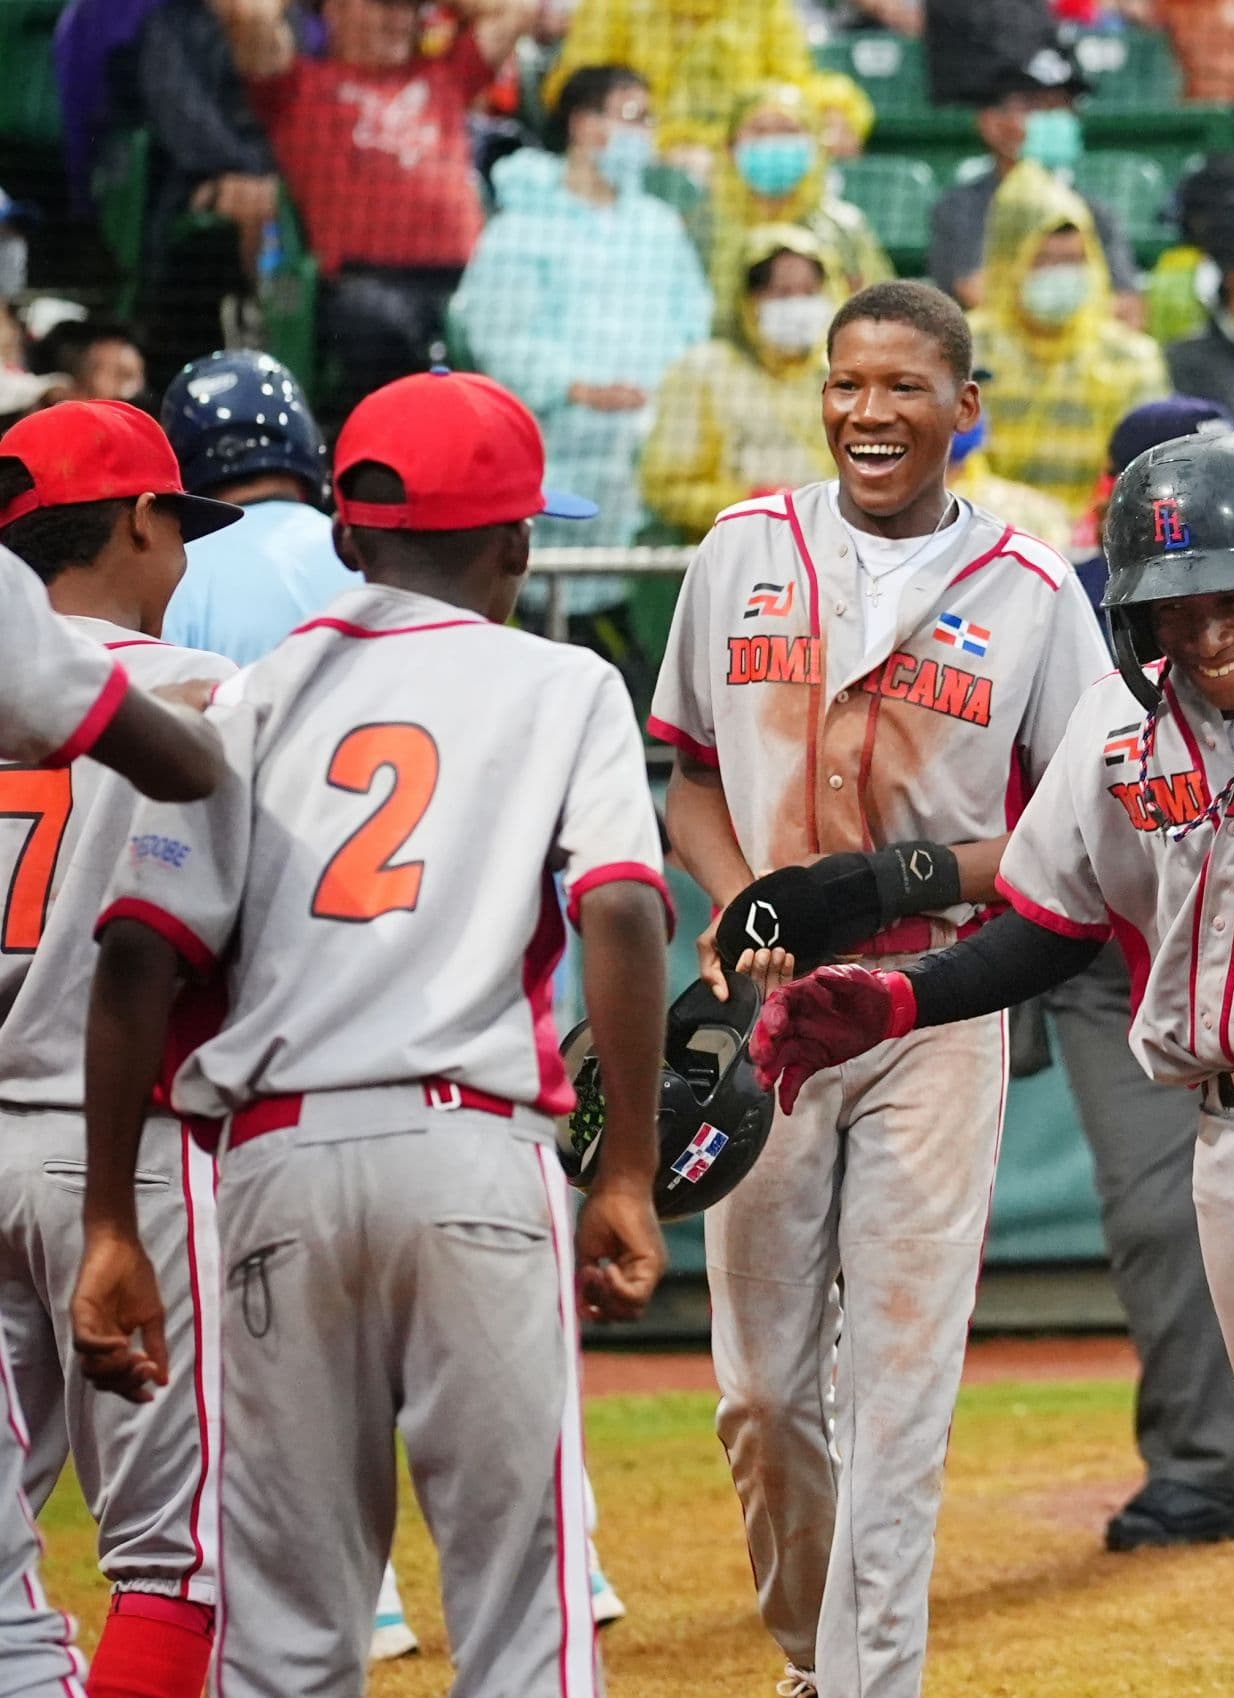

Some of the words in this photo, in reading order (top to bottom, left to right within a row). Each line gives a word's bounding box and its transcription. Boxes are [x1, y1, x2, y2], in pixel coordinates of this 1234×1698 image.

[726, 634, 994, 727] DOMICANA
[0, 761, 73, 955] 7
[310, 721, 440, 923] 2
